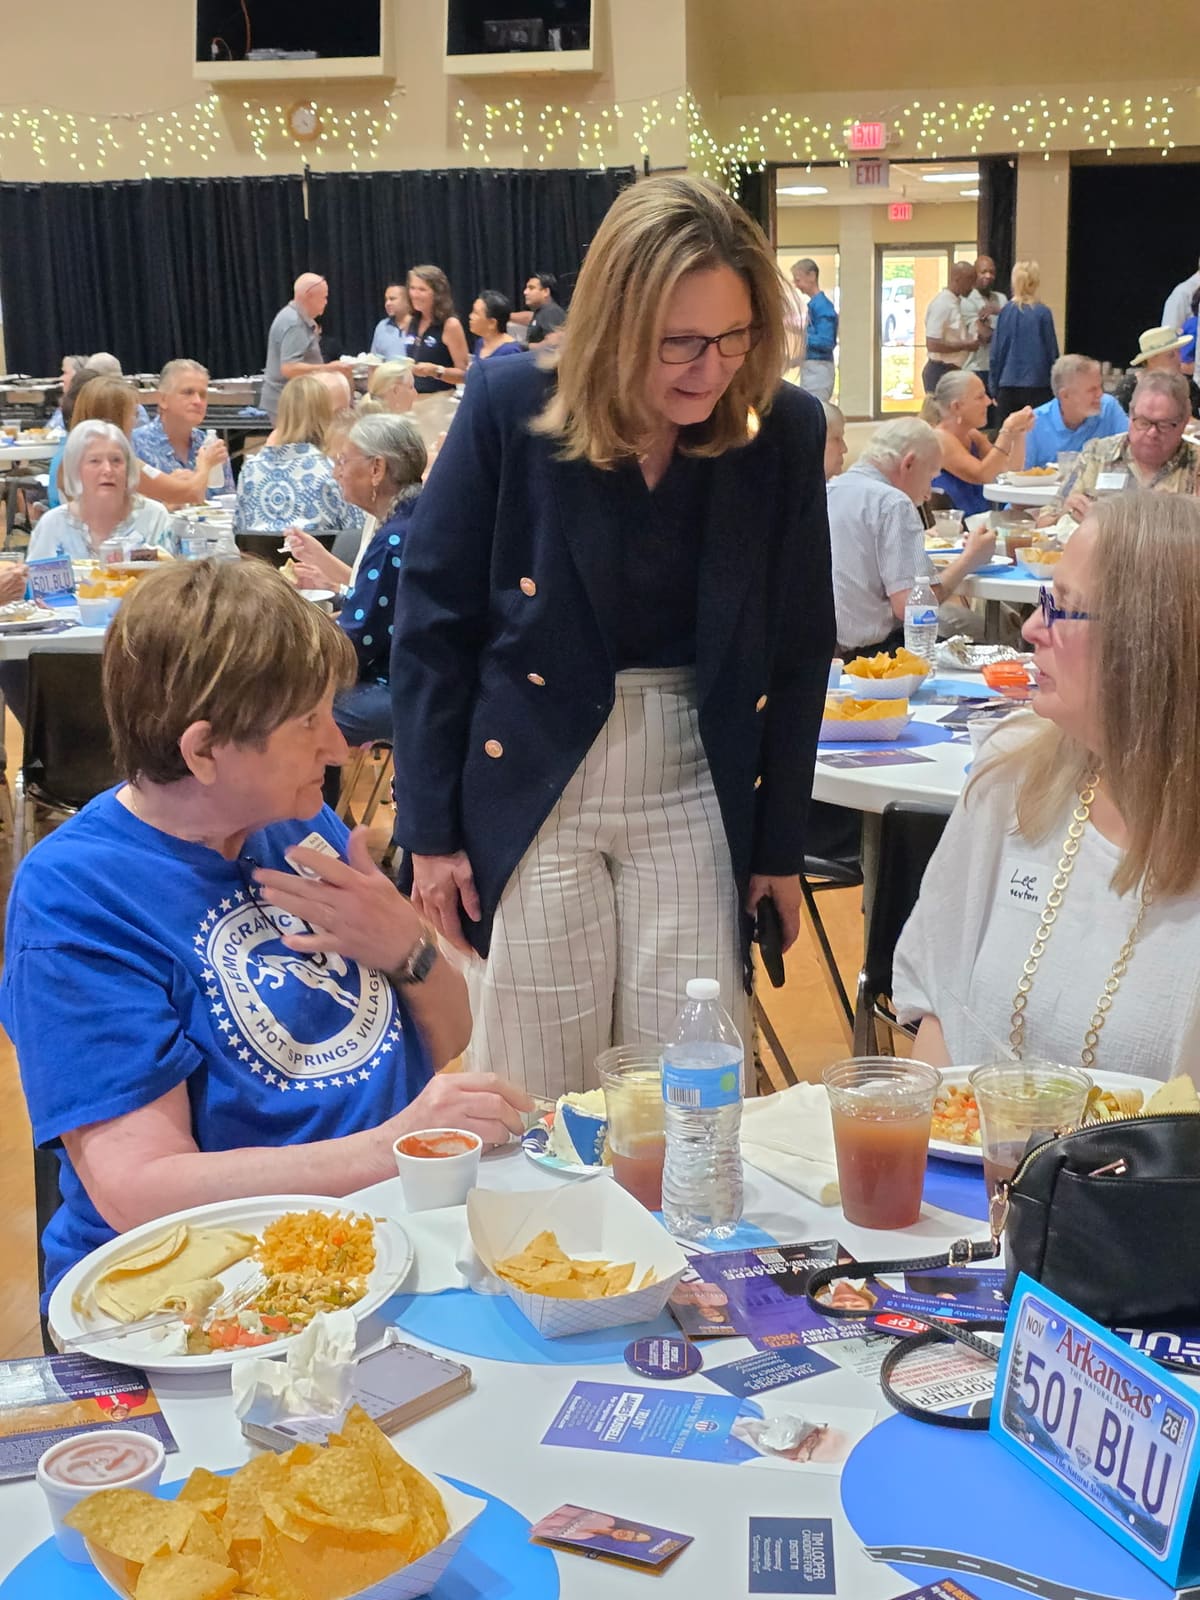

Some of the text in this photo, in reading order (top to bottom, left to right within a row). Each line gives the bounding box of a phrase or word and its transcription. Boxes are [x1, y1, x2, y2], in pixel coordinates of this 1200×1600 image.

[854, 125, 880, 149] EXIT
[856, 164, 881, 185] EXIT
[53, 572, 71, 590] BLU
[1010, 868, 1037, 891] Lee
[256, 967, 381, 1067] HOT SPRINGS VILLAGE
[901, 1303, 936, 1313] District
[801, 1326, 837, 1338] EVERY
[888, 1318, 910, 1327] OF
[1026, 1315, 1044, 1338] NOV
[802, 1333, 839, 1344] EVERY
[1056, 1327, 1154, 1418] Arkansas
[94, 1384, 144, 1397] PRIORITIES
[923, 1375, 987, 1394] FOR SENATE
[1070, 1367, 1135, 1420] THE NATURAL STATE
[604, 1394, 637, 1441] JAMES RUSSELL
[631, 1409, 651, 1430] TRUST
[1162, 1415, 1179, 1440] 26
[1024, 1351, 1172, 1515] 501 BLU
[1055, 1455, 1106, 1502] The Natural State
[789, 1539, 799, 1564] DISTRICT
[812, 1532, 826, 1580] TIM LOOPER
